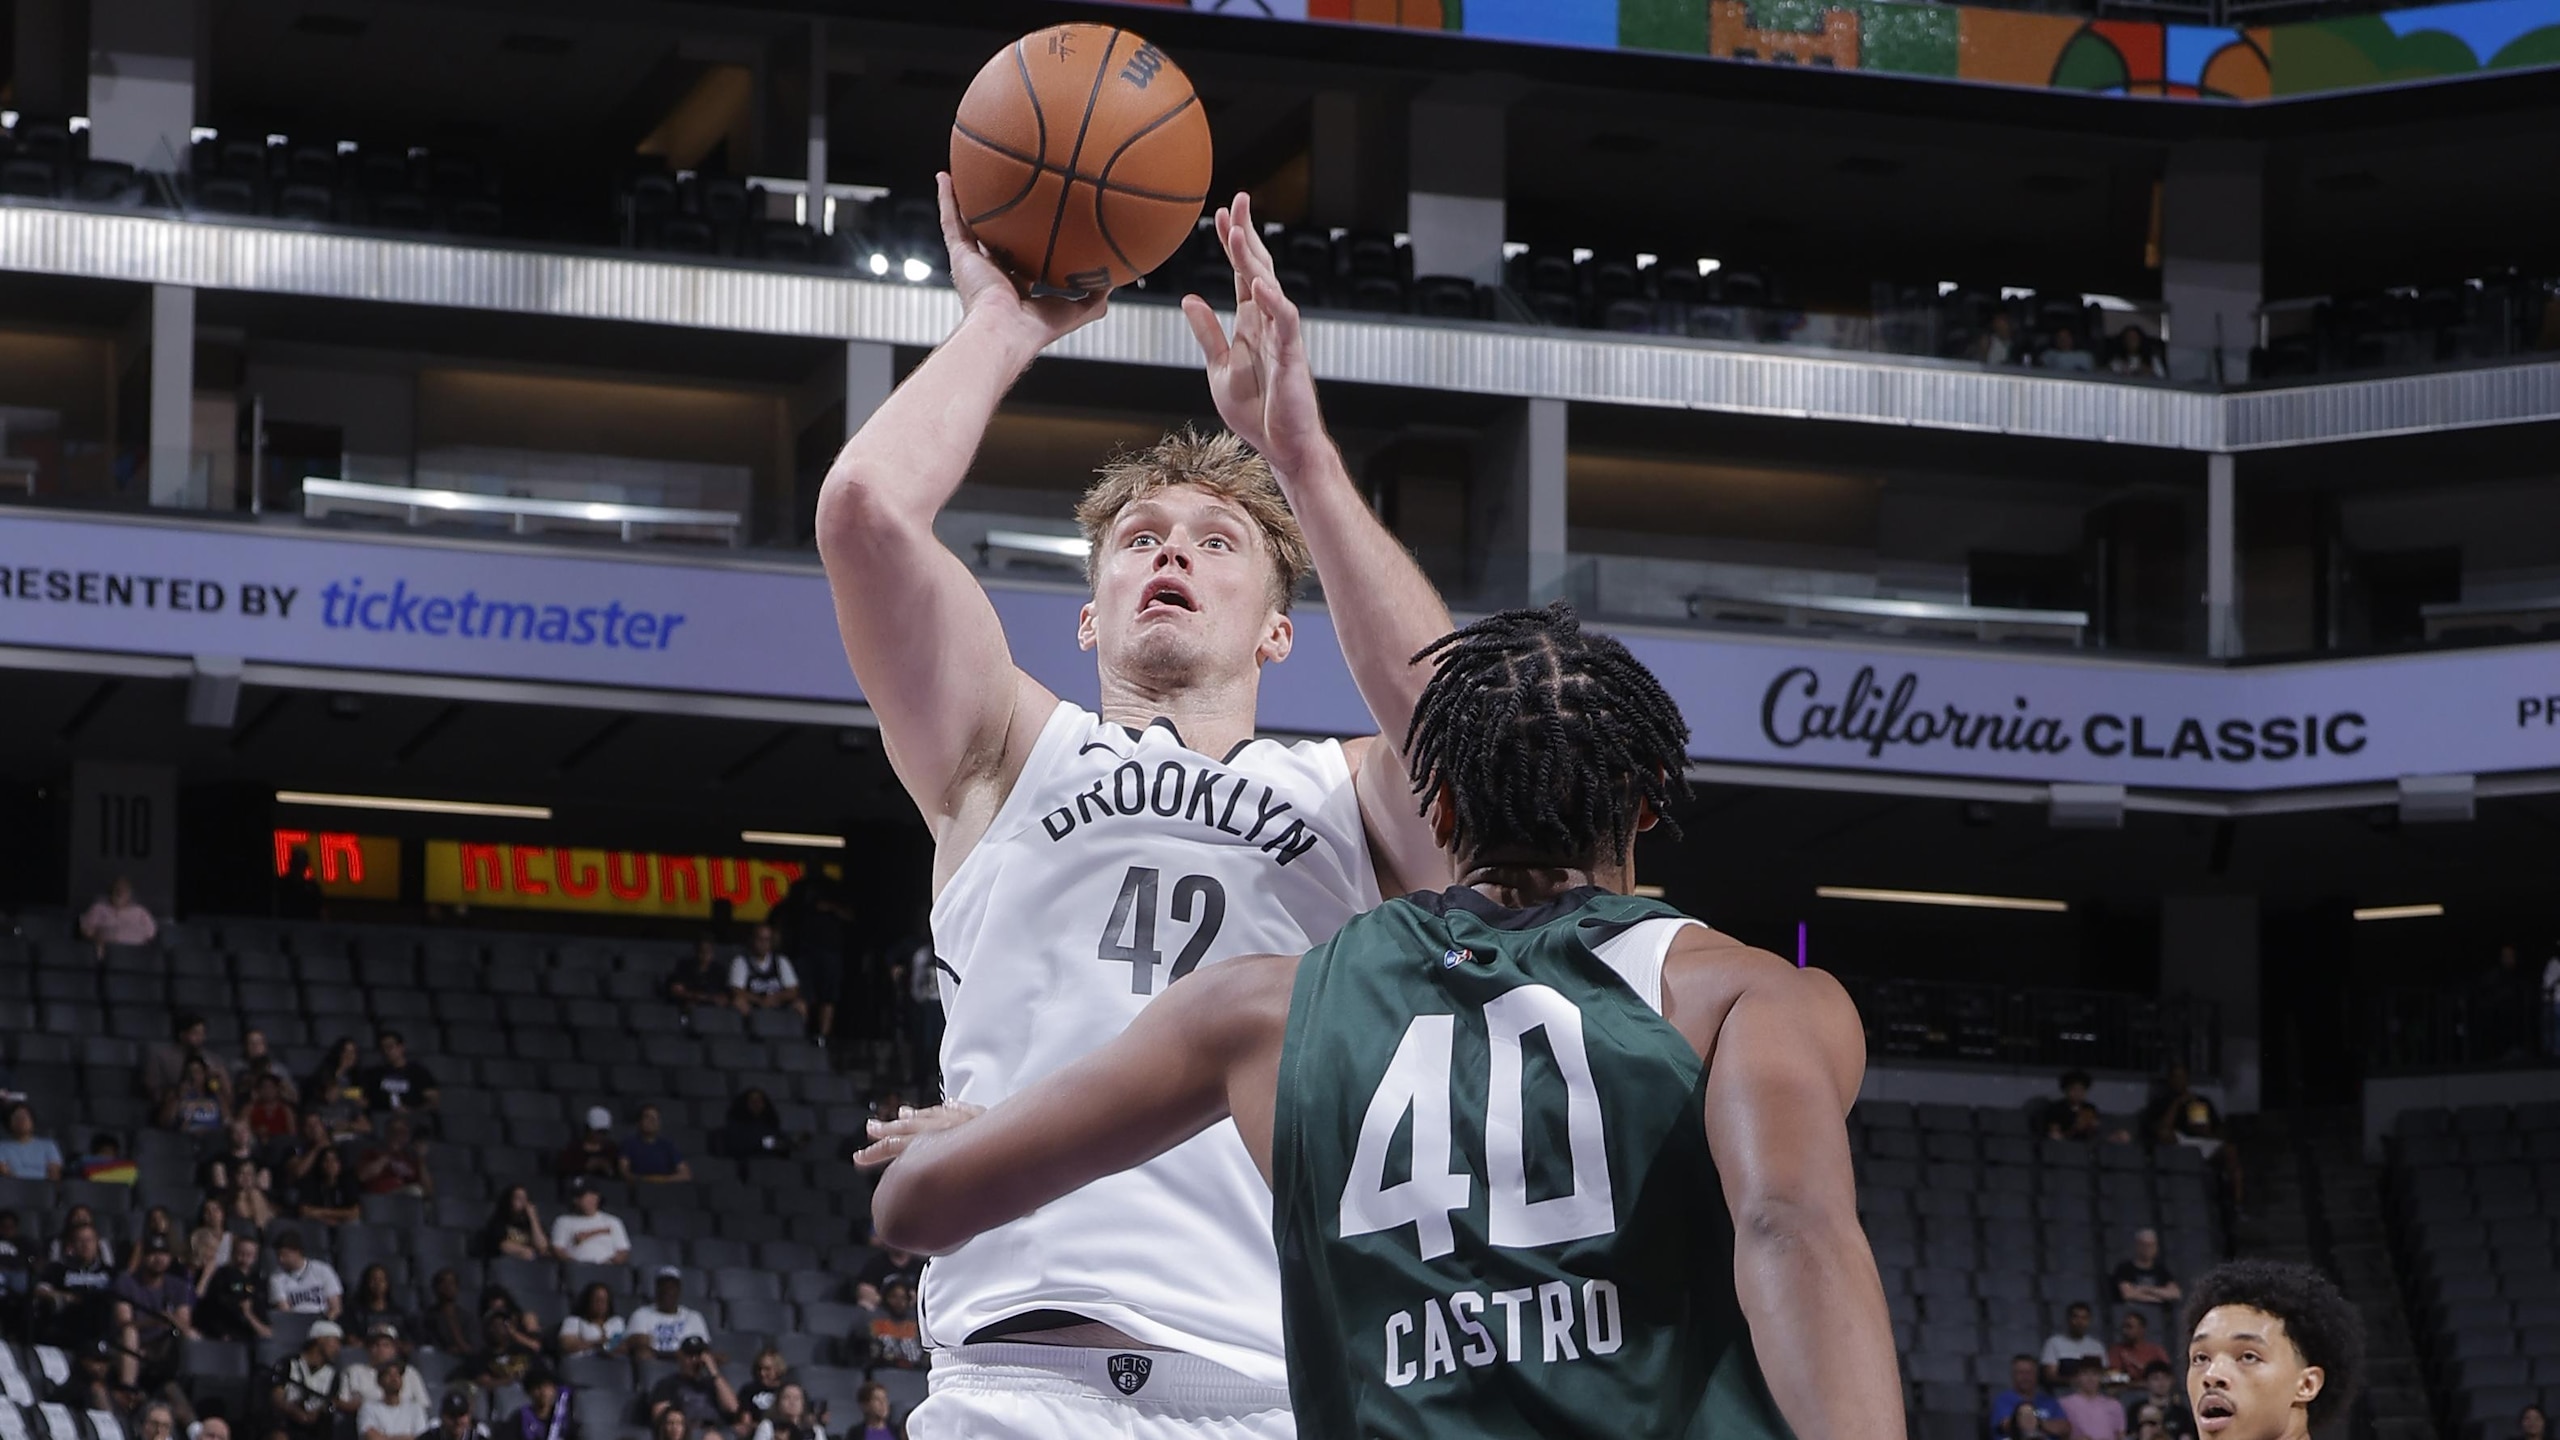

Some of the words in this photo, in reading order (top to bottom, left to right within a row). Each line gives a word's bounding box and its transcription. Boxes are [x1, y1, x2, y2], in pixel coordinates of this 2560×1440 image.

[240, 583, 299, 619] BY
[320, 577, 686, 651] ticketmaster
[1761, 665, 2071, 758] California
[2082, 711, 2367, 763] CLASSIC
[99, 792, 152, 859] 110
[1041, 759, 1318, 867] BROOKLYN
[1097, 865, 1226, 996] 42
[1339, 983, 1616, 1262] 40
[1111, 1356, 1148, 1374] NETS
[1384, 1278, 1624, 1388] CASTRO
